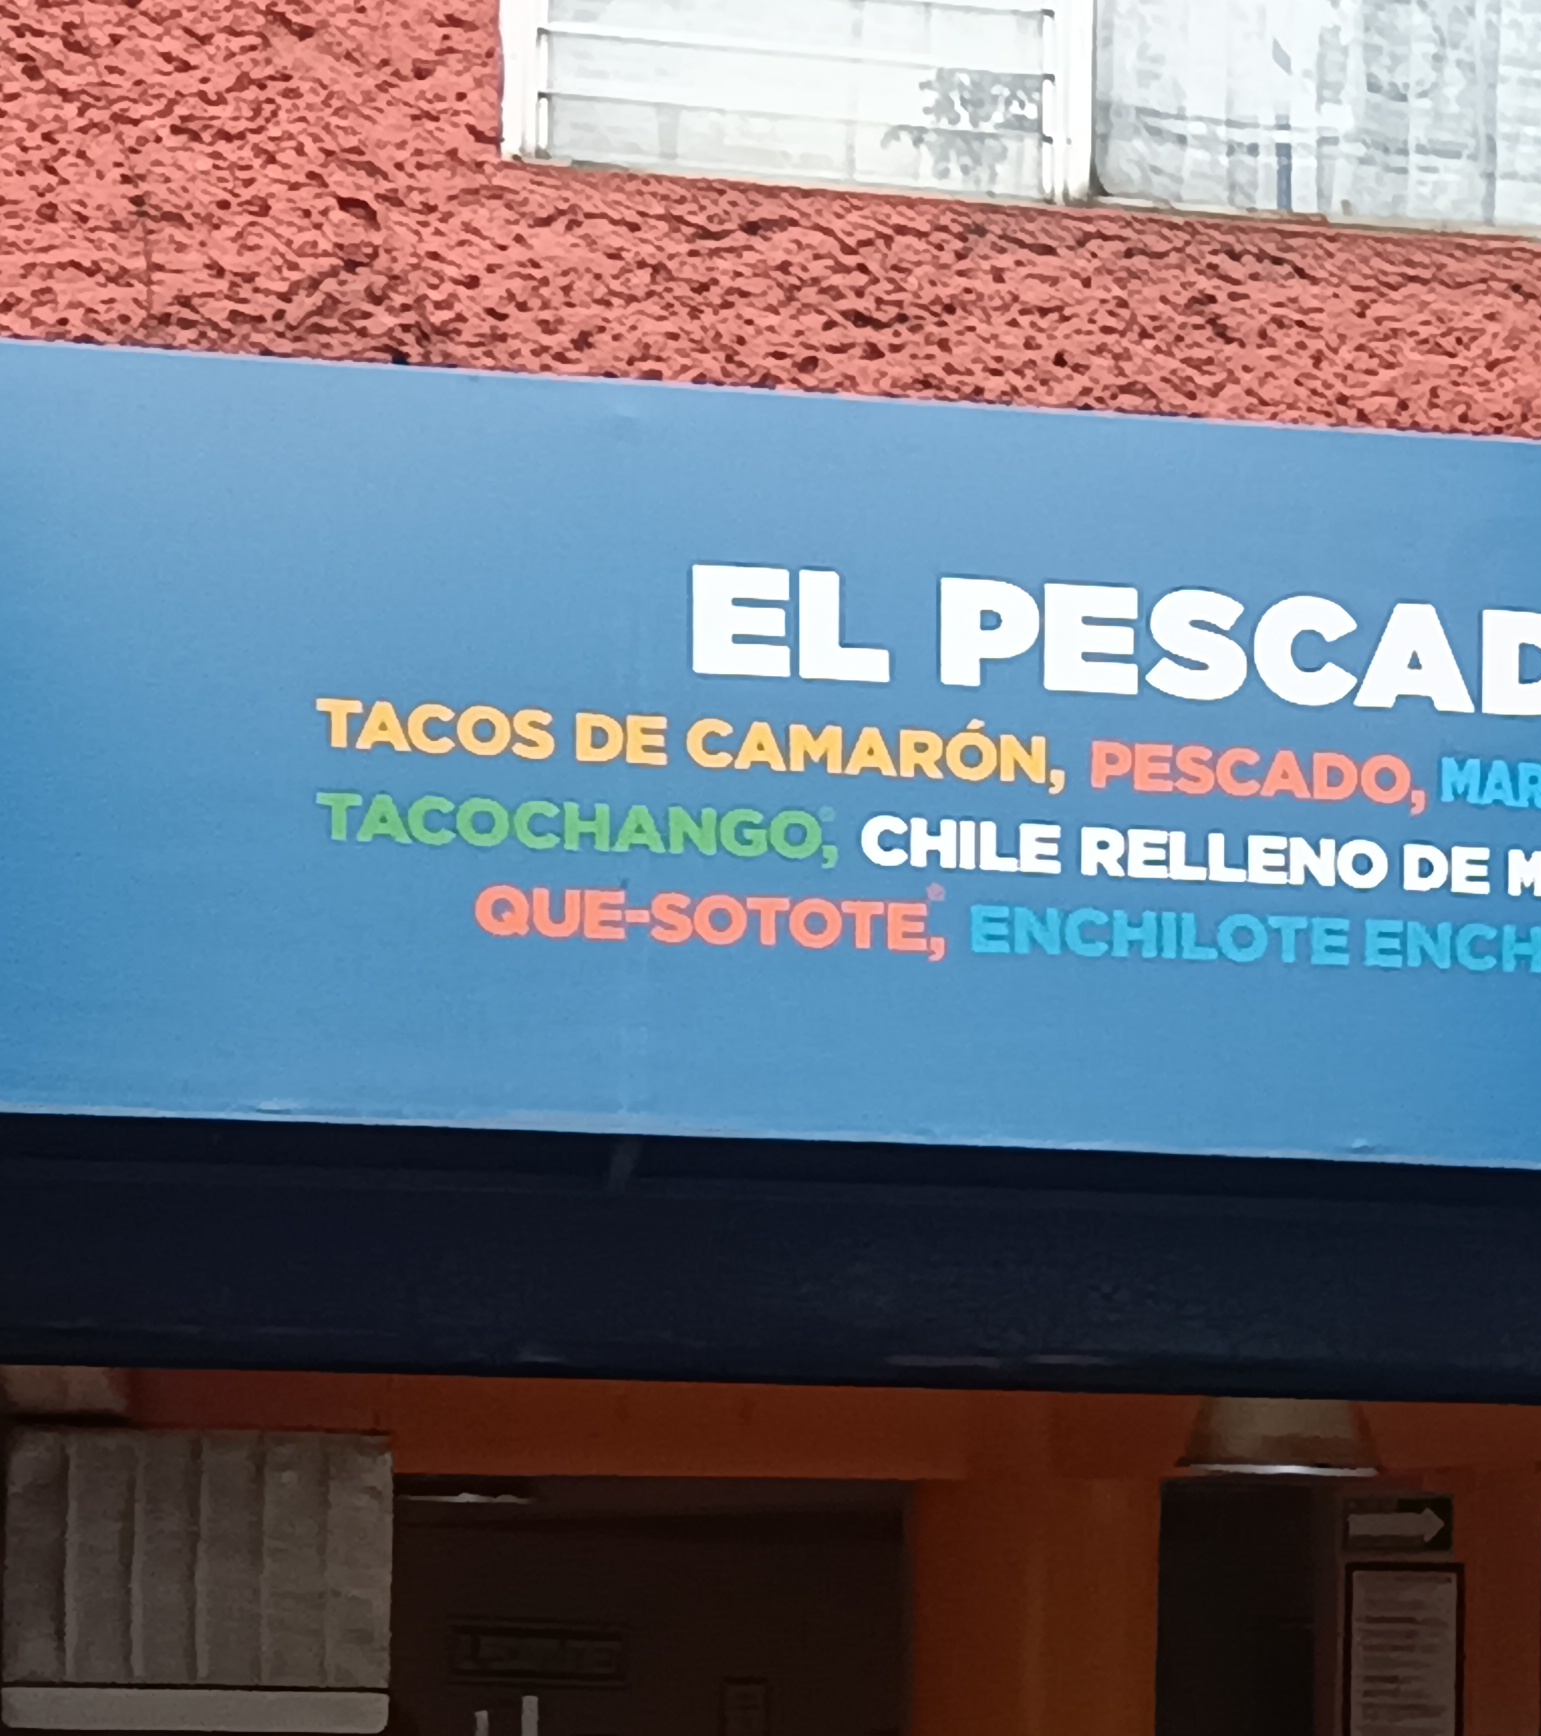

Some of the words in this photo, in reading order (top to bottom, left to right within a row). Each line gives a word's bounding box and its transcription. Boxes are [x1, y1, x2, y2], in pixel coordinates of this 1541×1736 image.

[692, 562, 890, 683] EL
[315, 697, 555, 761] TACOS
[575, 711, 668, 766] DE
[686, 719, 1066, 796] CAMARÓN,
[1090, 739, 1426, 817] PESCADO,
[315, 792, 839, 868] TACOCHANGO,
[860, 814, 1061, 876] CHILE
[1081, 828, 1388, 890] RELLENO
[1403, 843, 1490, 895] DE
[475, 884, 946, 961] QUE-SOTOTE,
[969, 904, 1350, 968] ENCHILOTE
